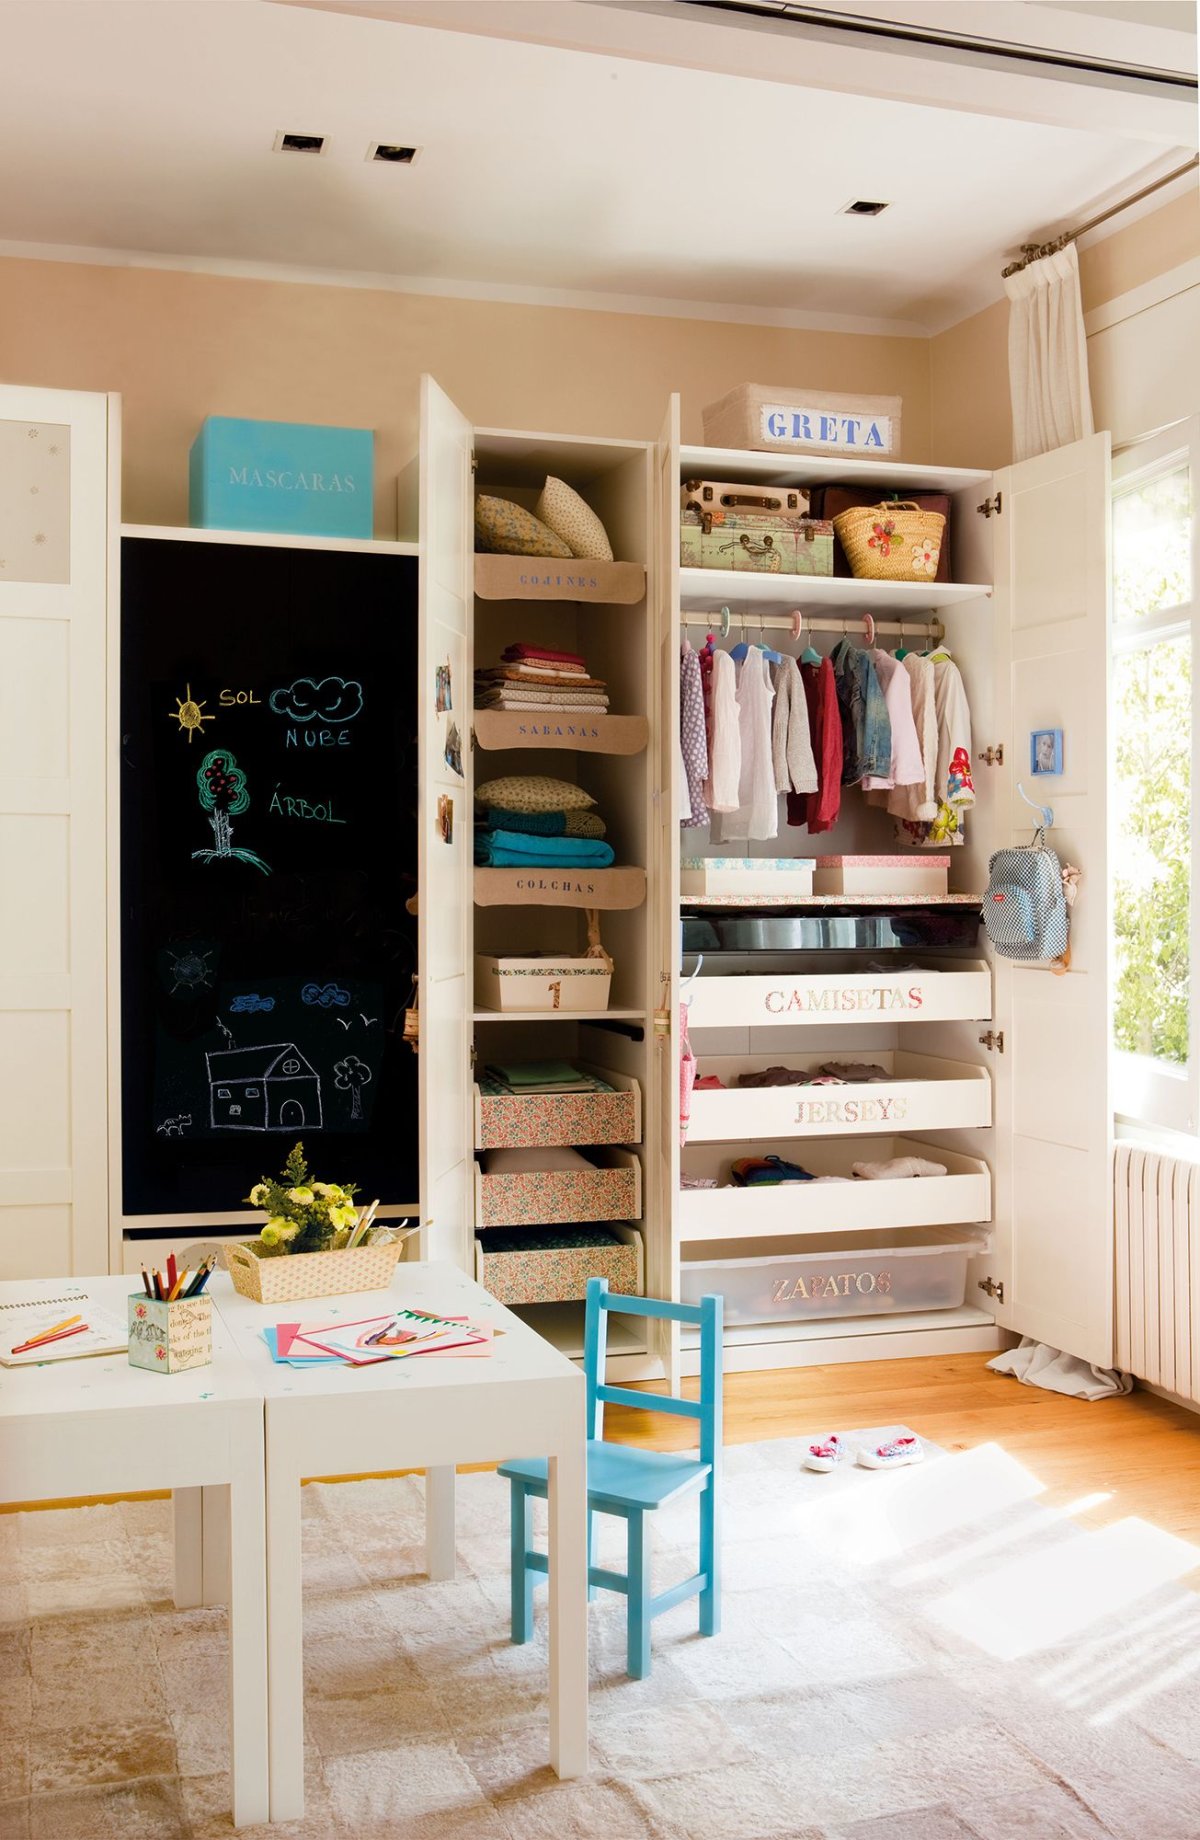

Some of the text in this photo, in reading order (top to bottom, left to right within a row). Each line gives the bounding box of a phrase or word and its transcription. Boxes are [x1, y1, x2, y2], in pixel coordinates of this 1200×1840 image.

[768, 413, 884, 447] GRETA
[228, 466, 357, 493] MASCARAS
[519, 575, 598, 587] COJINES
[219, 689, 262, 706] SOL
[286, 729, 351, 747] NUBE
[519, 725, 600, 738] SABANAS
[269, 783, 346, 824] ÁRBOL
[516, 879, 595, 893] COLCHAS
[548, 980, 561, 1009] 1
[765, 987, 923, 1014] CAMISETAS
[794, 1098, 908, 1124] JERSEYS
[773, 1271, 892, 1303] ZAPATOS
